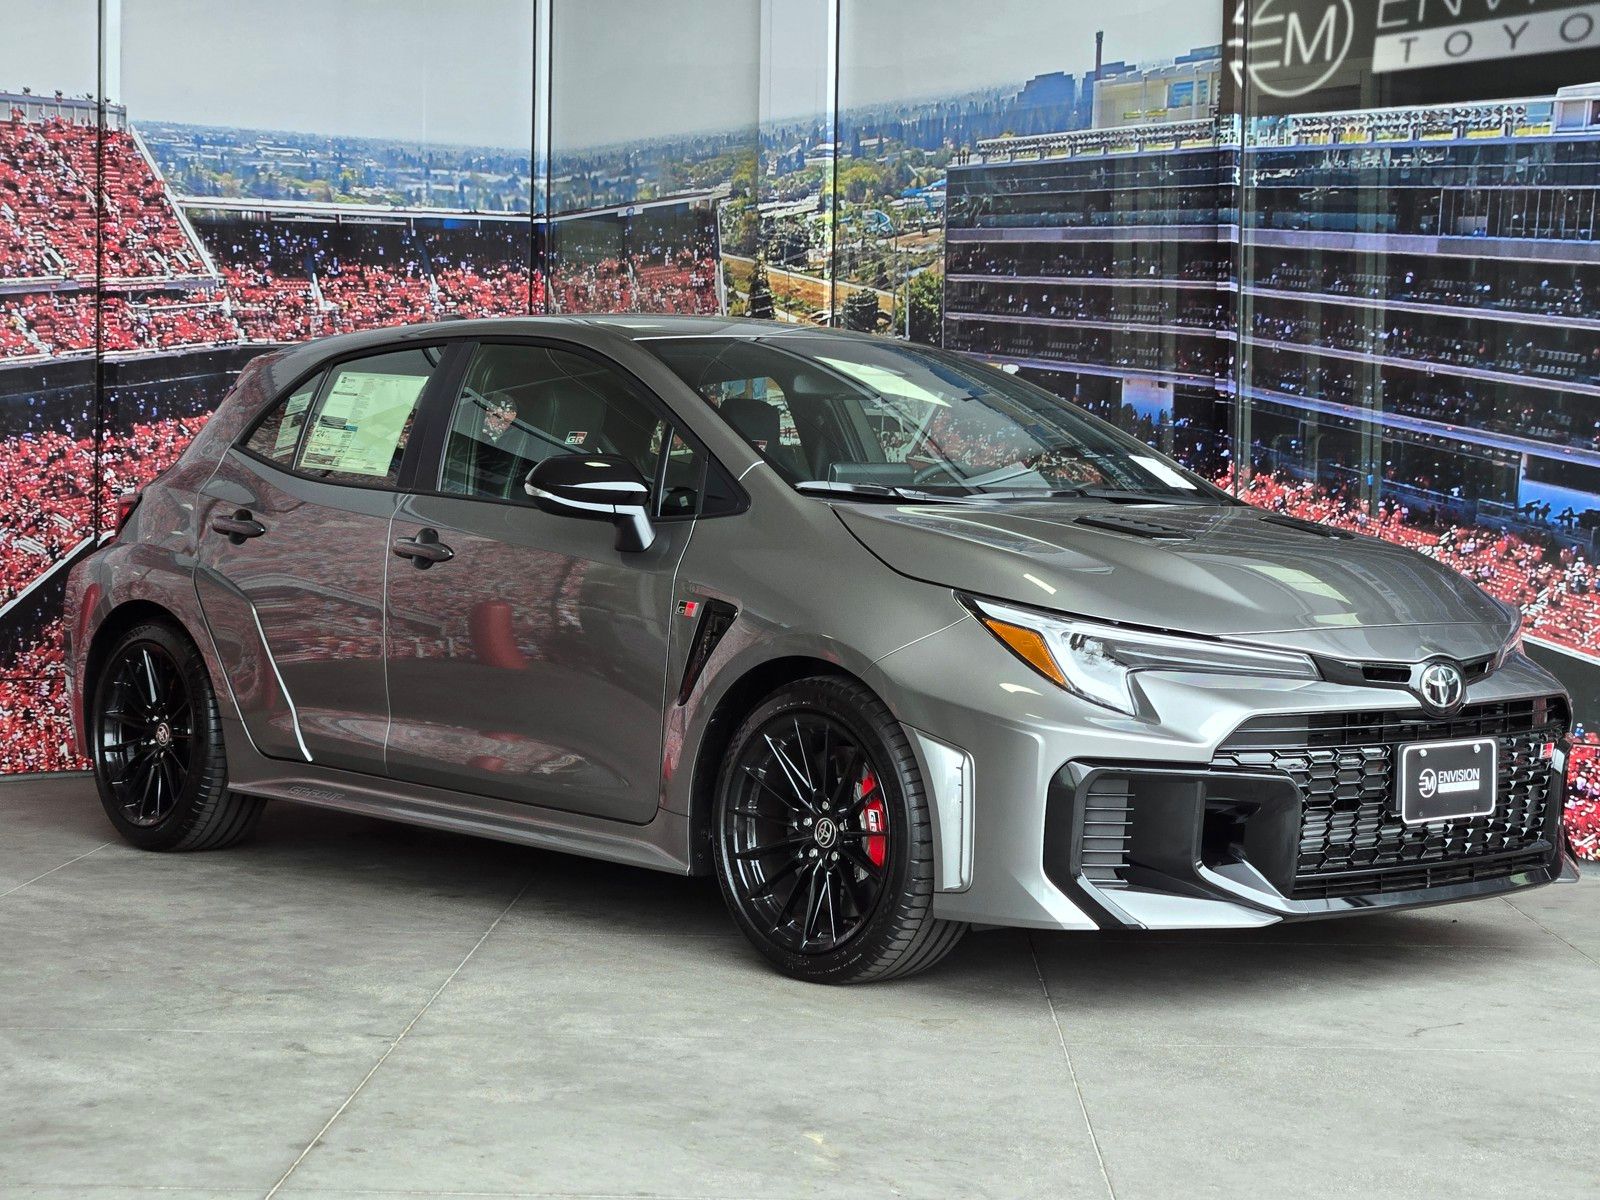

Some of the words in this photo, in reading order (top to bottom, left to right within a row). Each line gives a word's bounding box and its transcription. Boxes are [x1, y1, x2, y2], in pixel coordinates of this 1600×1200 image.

[1400, 12, 1594, 63] TOYO
[566, 435, 586, 444] GR
[1438, 768, 1480, 784] ENVISION
